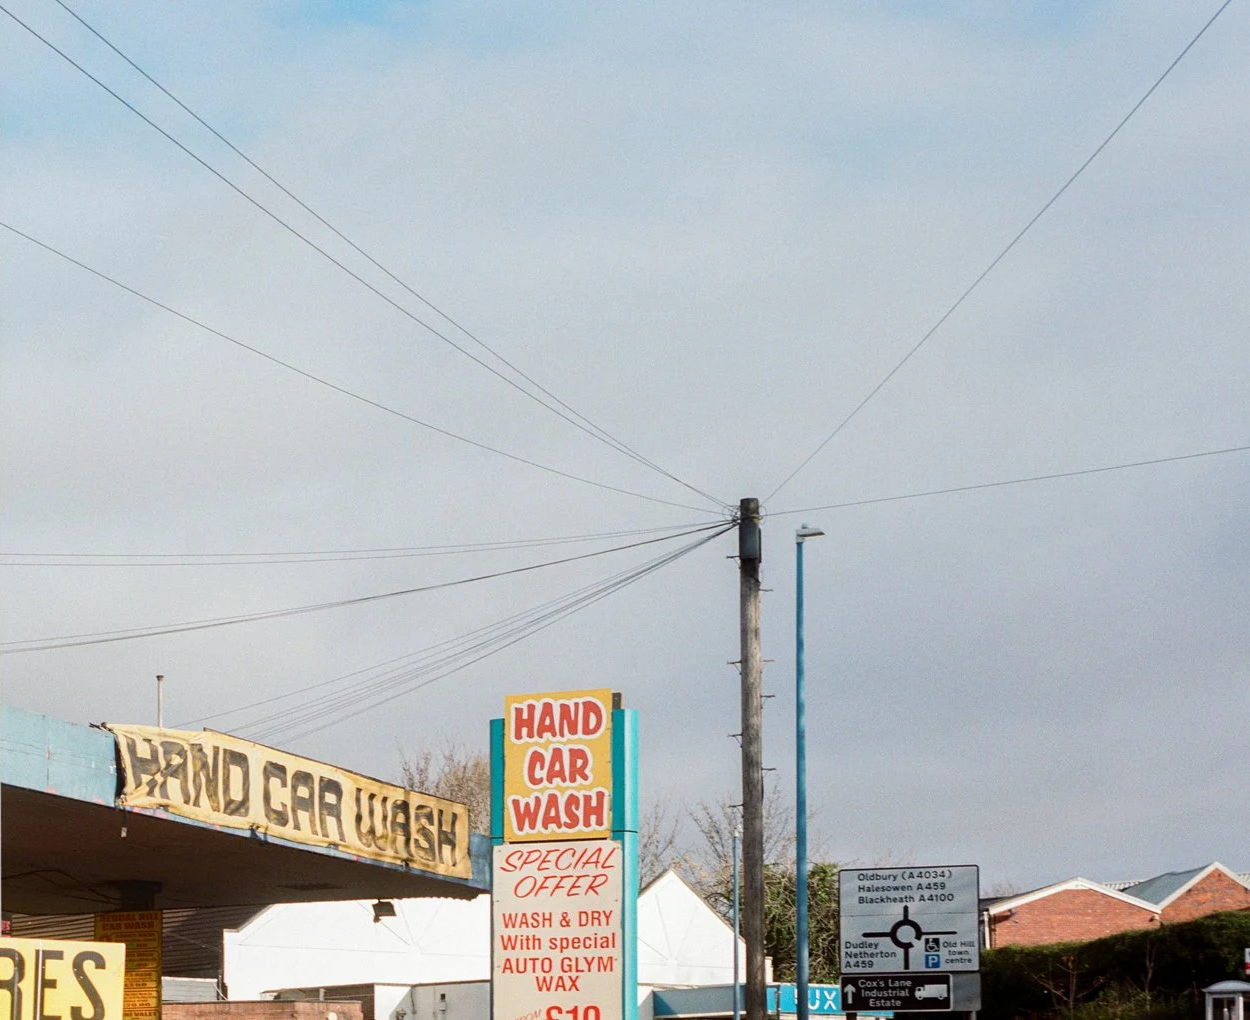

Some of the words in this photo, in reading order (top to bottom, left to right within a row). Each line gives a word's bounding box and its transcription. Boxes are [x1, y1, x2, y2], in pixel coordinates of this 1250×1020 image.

[514, 700, 603, 740] HAND
[527, 747, 589, 786] CAR
[124, 734, 250, 817] HAND
[263, 761, 347, 843] CAR
[355, 787, 458, 867] WASH
[512, 790, 605, 832] WASH
[499, 847, 619, 873] SPECIAL
[857, 873, 898, 882] Oldbury
[901, 870, 952, 880] (A4034)
[513, 873, 608, 899] OFFER
[858, 884, 913, 893] Halesowen
[916, 882, 946, 891] A459
[858, 895, 915, 905] Blackheath
[918, 893, 955, 903] A4100
[503, 912, 552, 929] WASH
[559, 911, 571, 927] &
[578, 910, 613, 927] DRY
[500, 933, 542, 951] With
[549, 932, 616, 954] special
[844, 941, 879, 950] Dudley
[844, 950, 897, 959] Netherton
[502, 957, 552, 974] AUTO
[560, 956, 614, 973] GLYM
[844, 960, 874, 969] A459
[535, 975, 580, 992] WAX
[858, 979, 885, 988] Cox's
[888, 979, 912, 988] Lane
[861, 988, 910, 998] Industrial
[869, 999, 902, 1008] Estate
